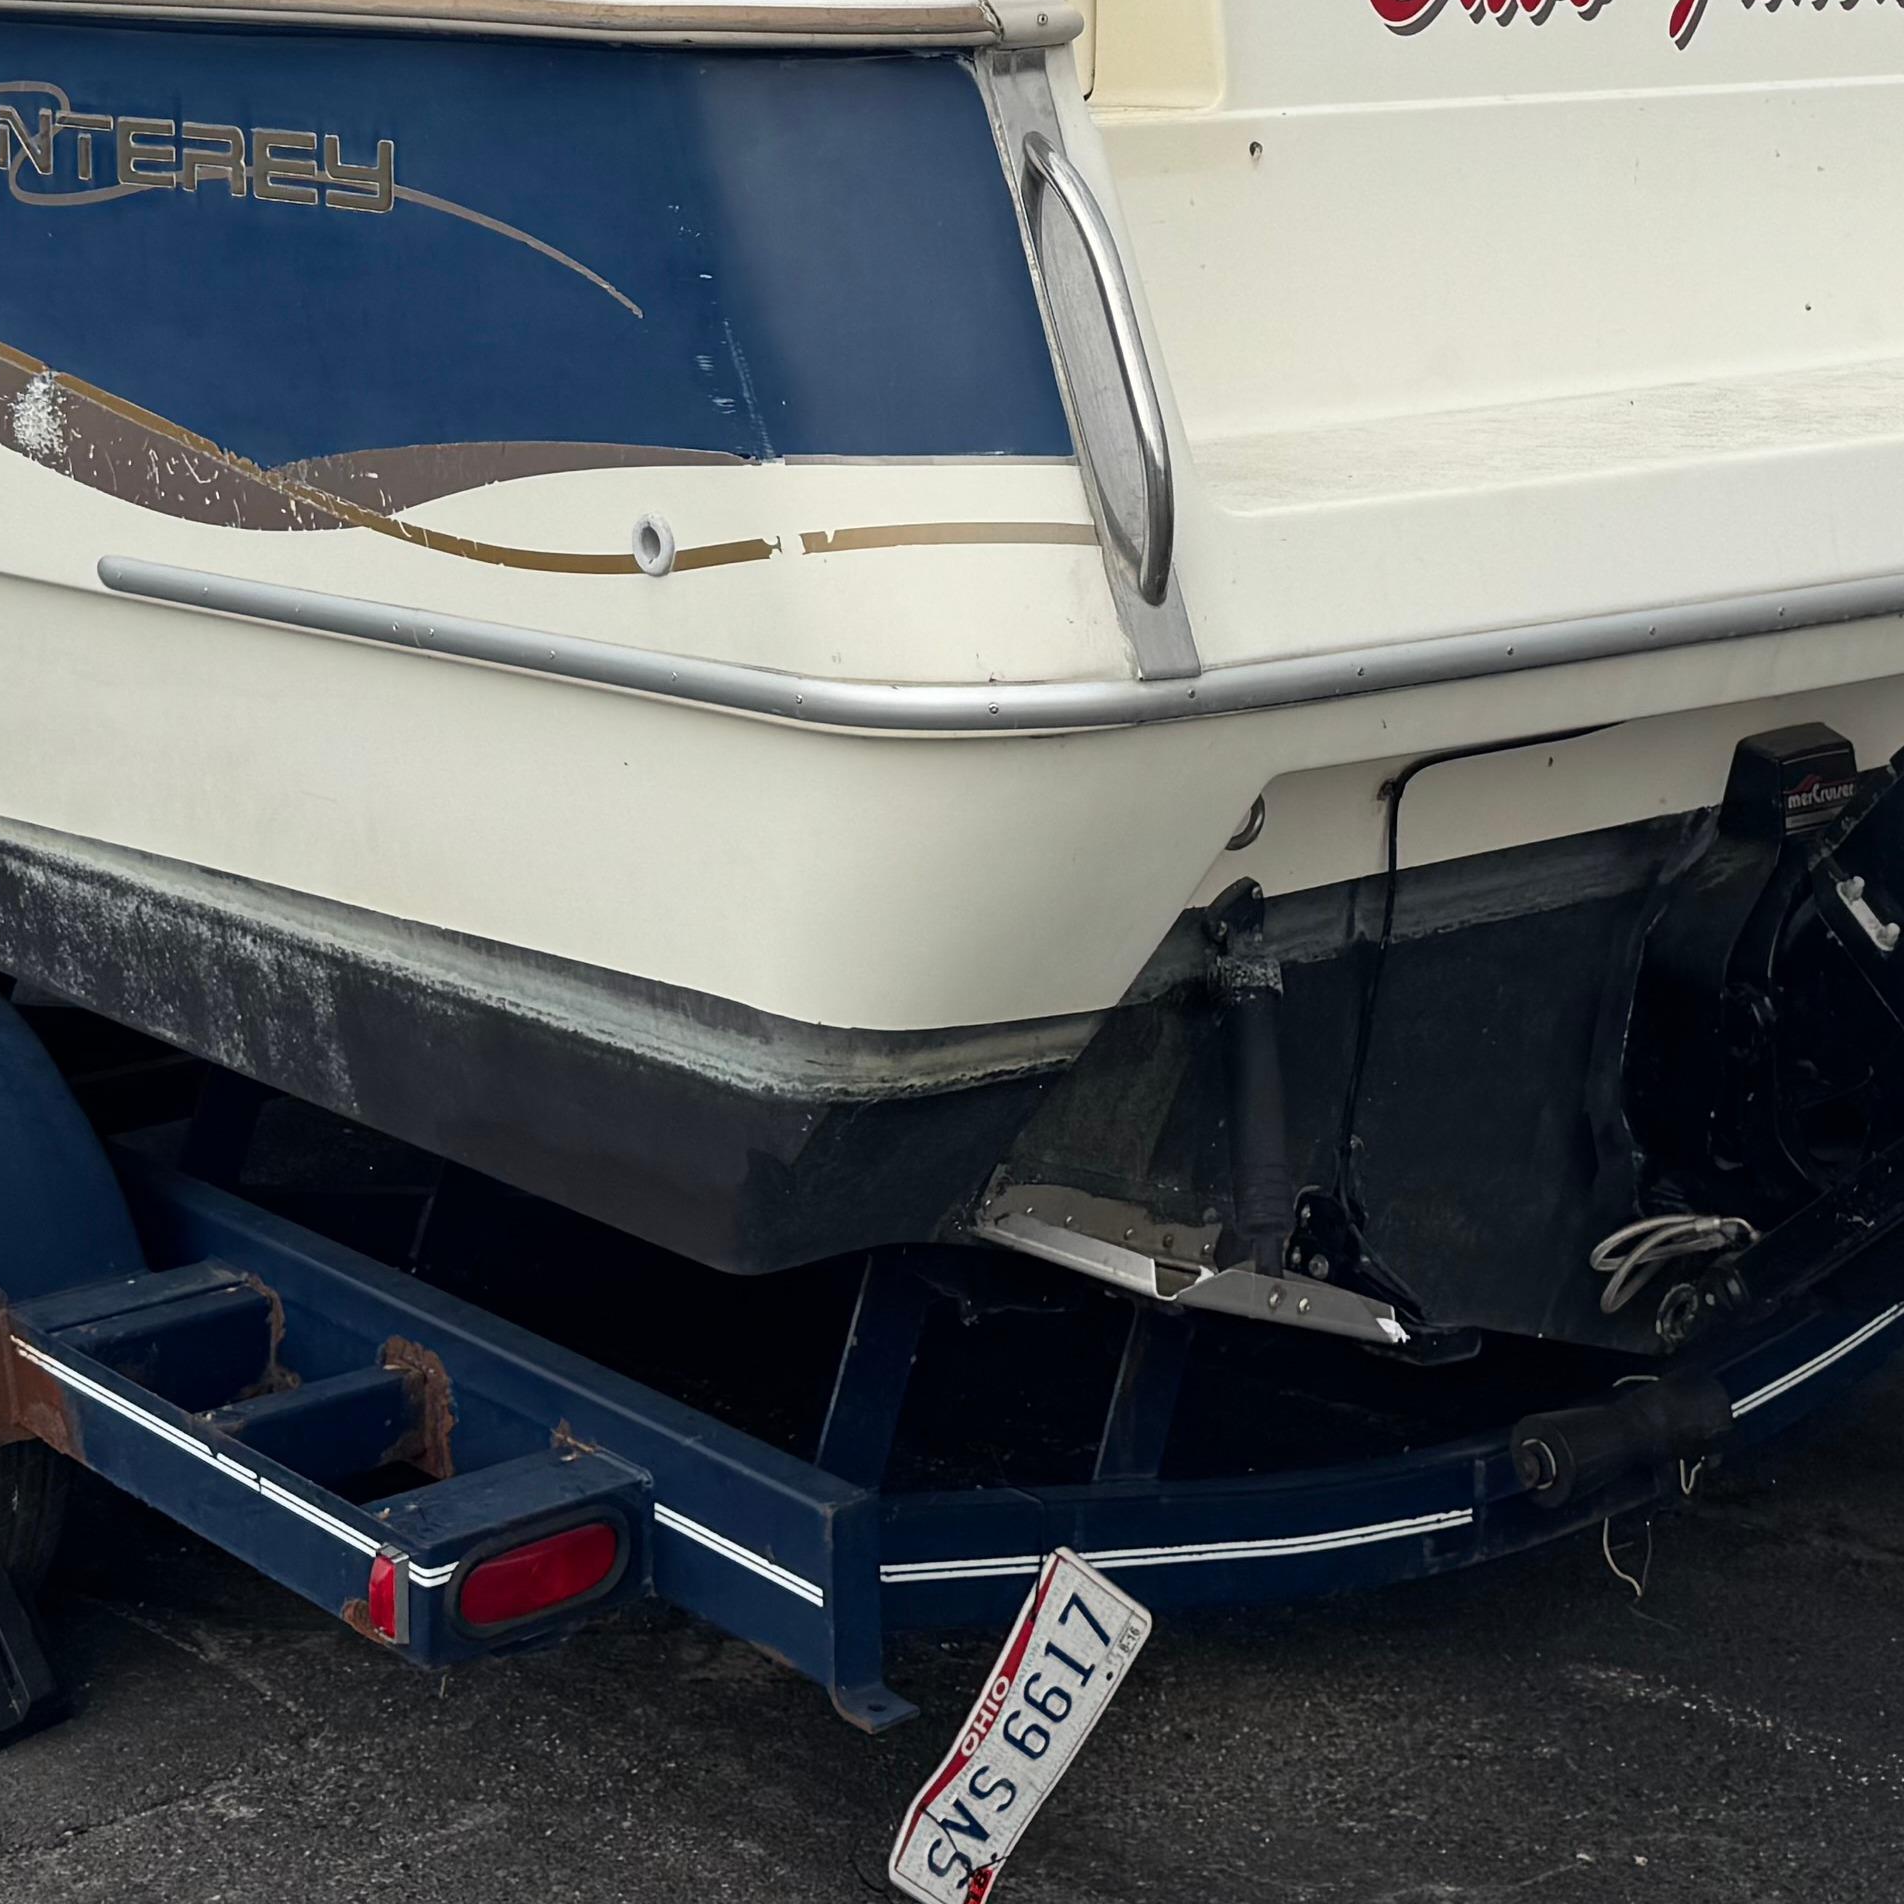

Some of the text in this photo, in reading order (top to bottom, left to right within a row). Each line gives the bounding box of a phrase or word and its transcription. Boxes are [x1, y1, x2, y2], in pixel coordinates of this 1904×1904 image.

[927, 1593, 1111, 1889] SVS 6617
[960, 1675, 1010, 1757] OHIO
